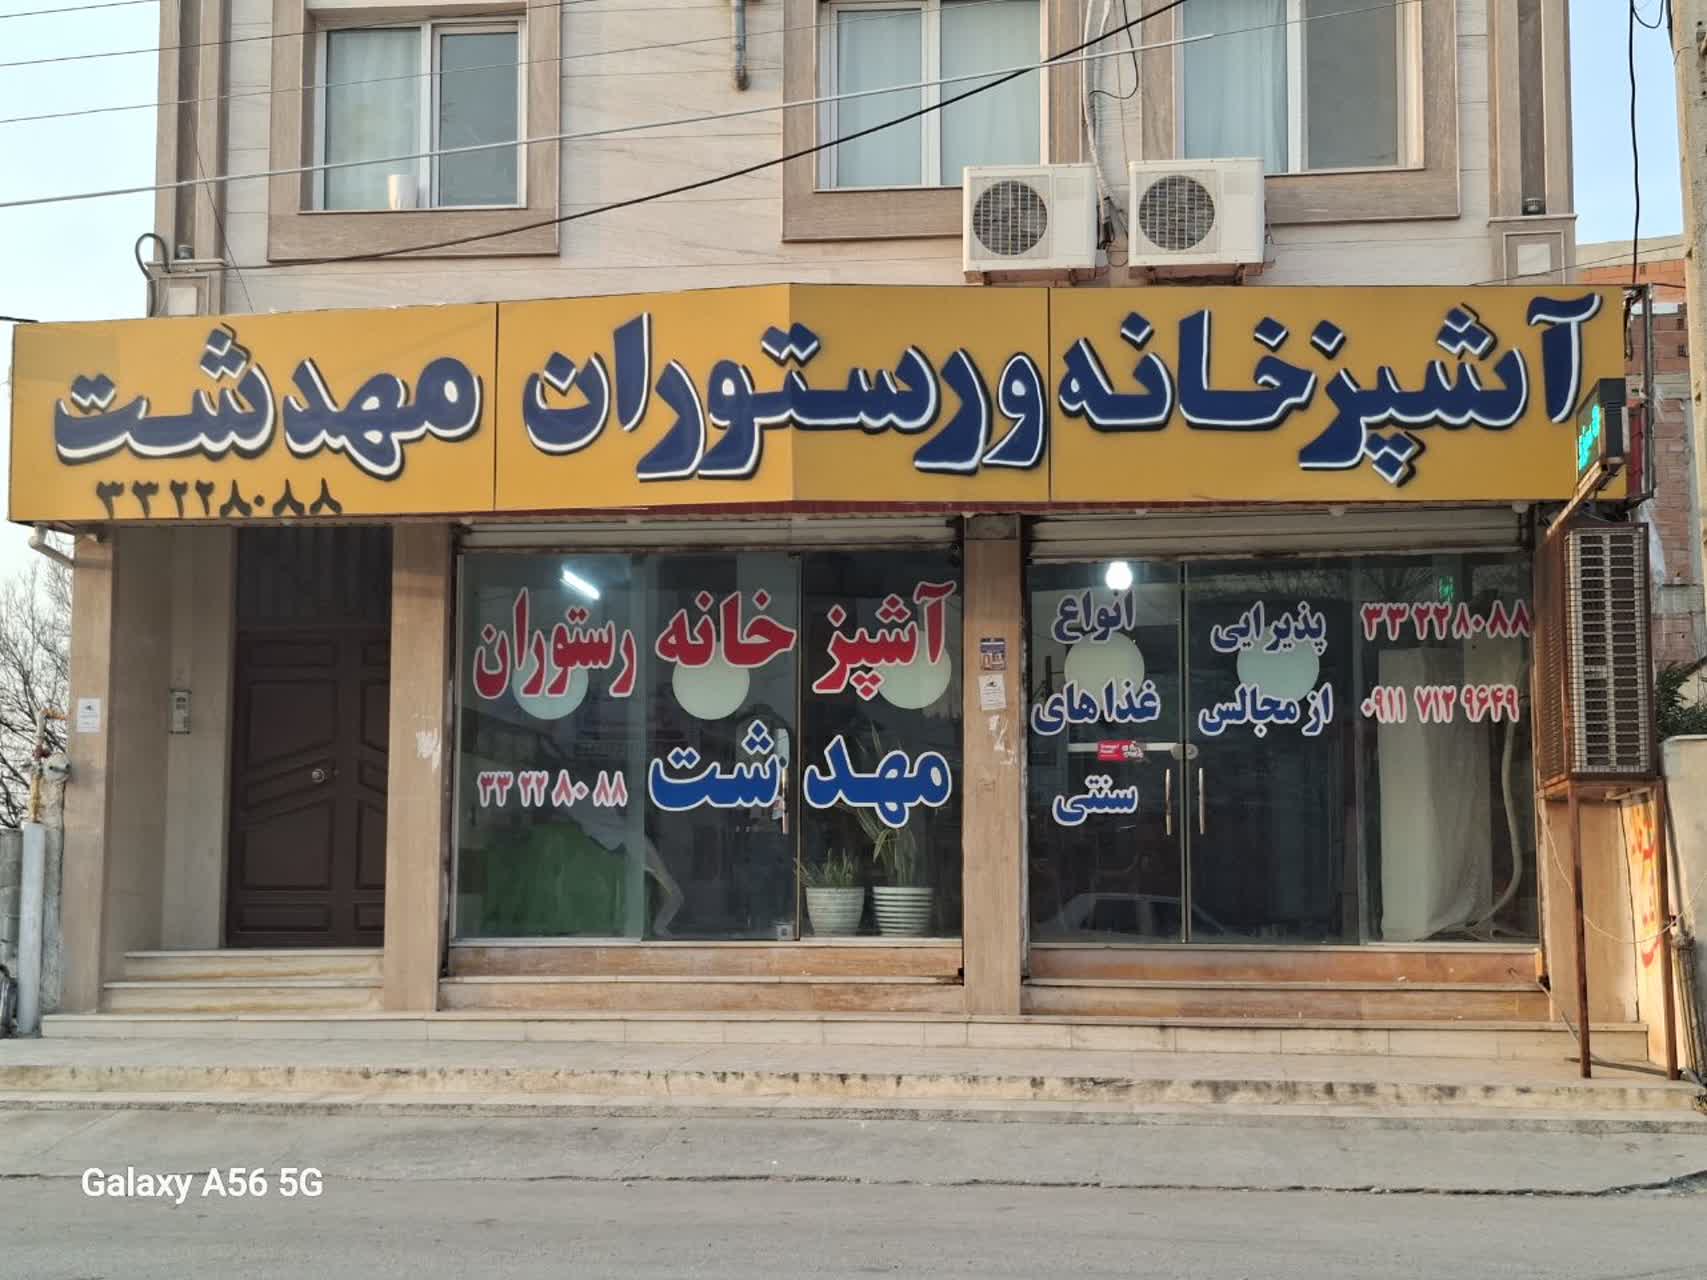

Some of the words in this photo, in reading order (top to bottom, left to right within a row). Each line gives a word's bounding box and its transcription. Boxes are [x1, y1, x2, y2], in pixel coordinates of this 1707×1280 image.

[54, 322, 483, 480] مهدشت
[96, 478, 342, 519] ۳۳۲۲۸۰۸۸
[473, 588, 637, 699] رستوران
[1051, 590, 1137, 644] انواع
[1210, 600, 1327, 655] پذیرایی
[1199, 683, 1300, 737] مجالس
[1301, 682, 1334, 736] از
[1360, 686, 1407, 723] ۰۹۱۱
[1052, 774, 1138, 825] سنتی
